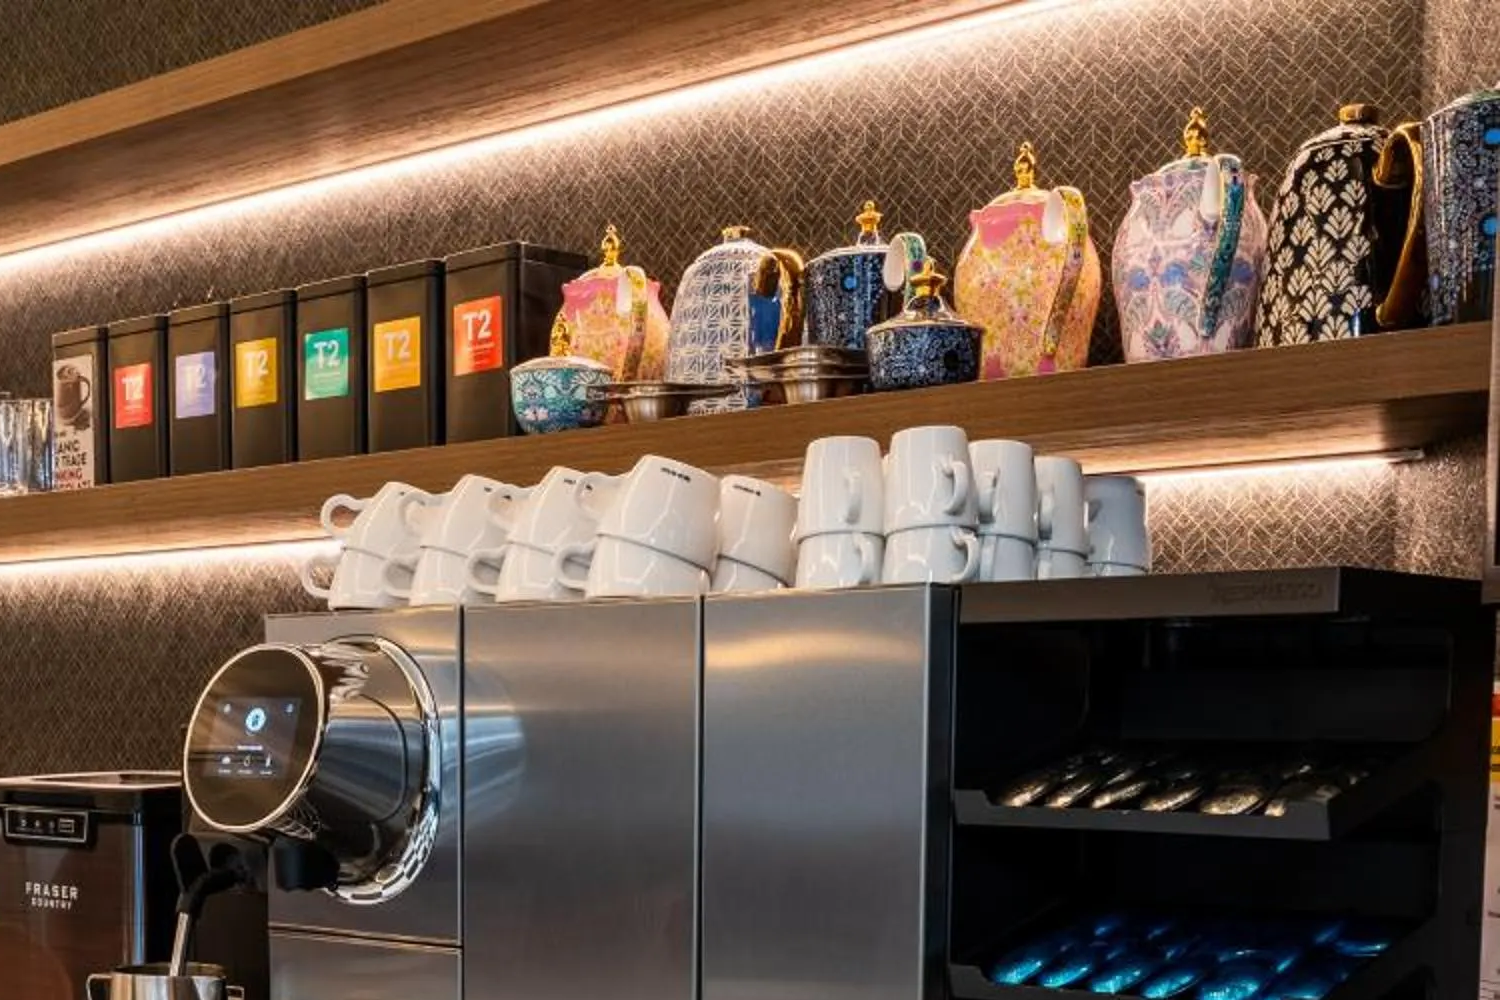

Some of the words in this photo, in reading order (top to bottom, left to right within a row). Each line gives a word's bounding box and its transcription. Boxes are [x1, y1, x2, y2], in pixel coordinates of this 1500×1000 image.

[461, 308, 493, 341] T2
[313, 339, 341, 369] T2
[384, 329, 411, 361] T2
[184, 363, 207, 393] T2
[243, 350, 269, 380] T2
[121, 374, 144, 401] T2
[25, 881, 79, 901] FRASER
